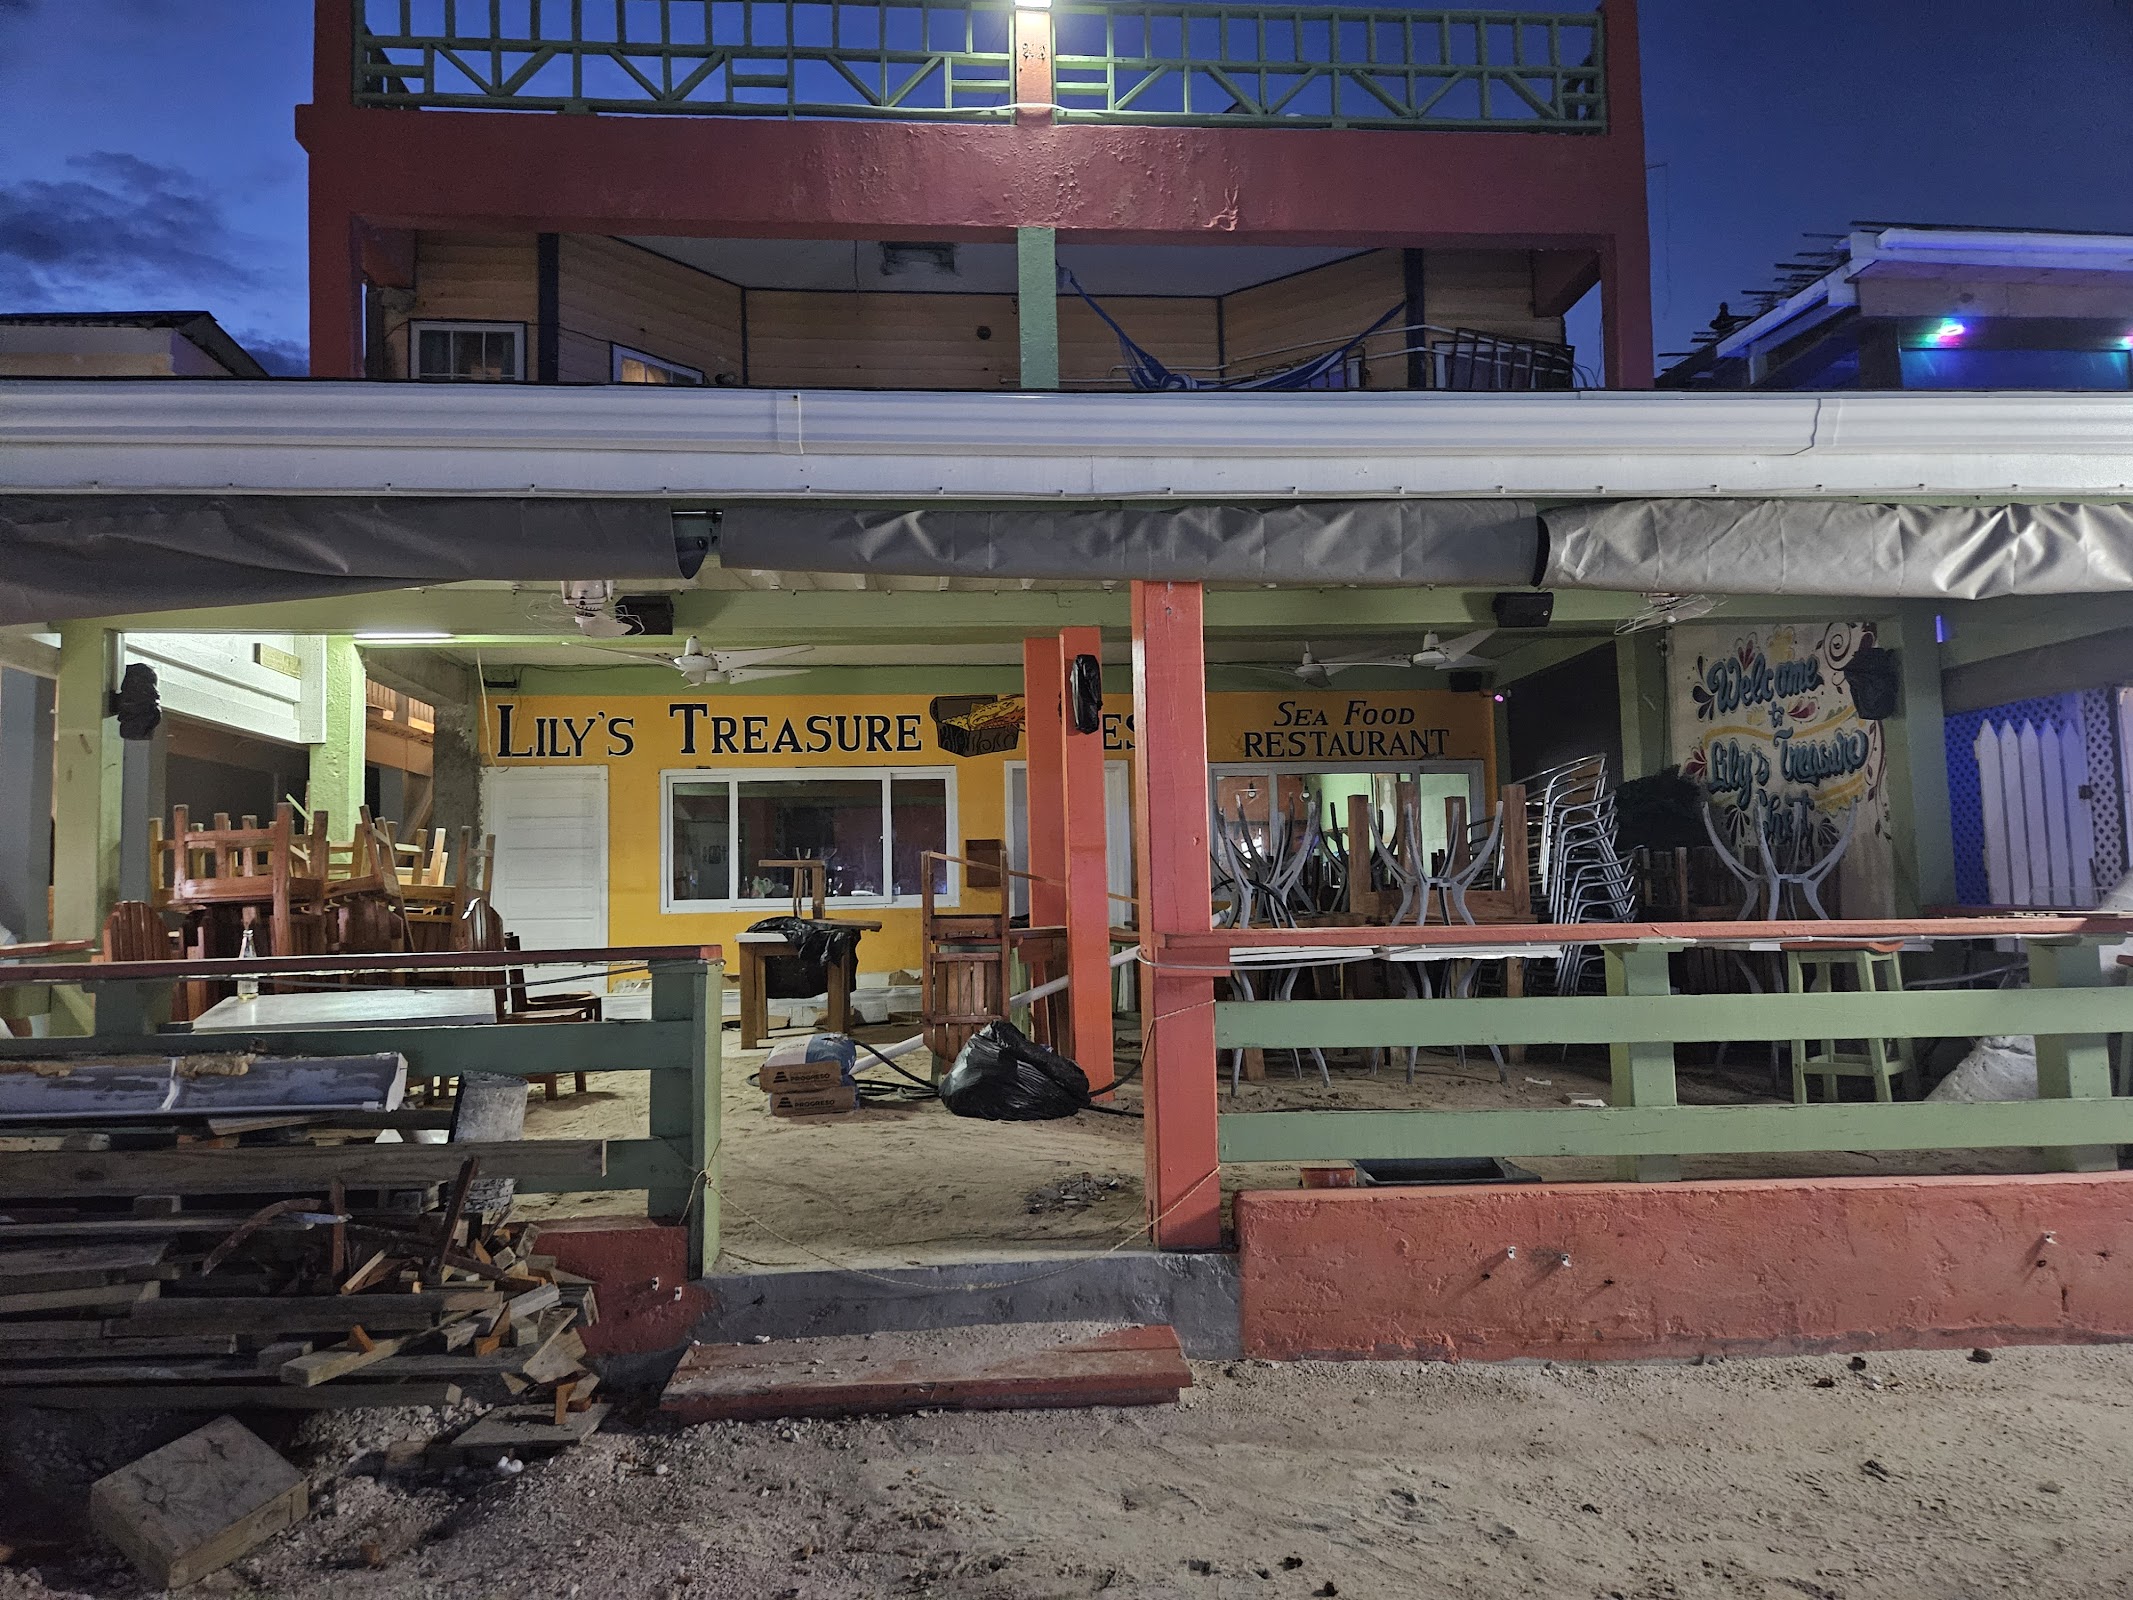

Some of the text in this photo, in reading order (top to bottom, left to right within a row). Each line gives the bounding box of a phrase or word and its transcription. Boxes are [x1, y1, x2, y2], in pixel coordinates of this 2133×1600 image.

[1706, 652, 1824, 713] Welcome
[496, 702, 923, 758] LILY'S TREASURE
[1273, 700, 1415, 727] SEA FOOD
[1243, 729, 1450, 758] RESTAURANT
[1707, 727, 1869, 811] Lily's Treasure
[1756, 788, 1815, 846] het
[790, 1073, 831, 1082] PROGRESO
[794, 1099, 835, 1108] PROGRESO
